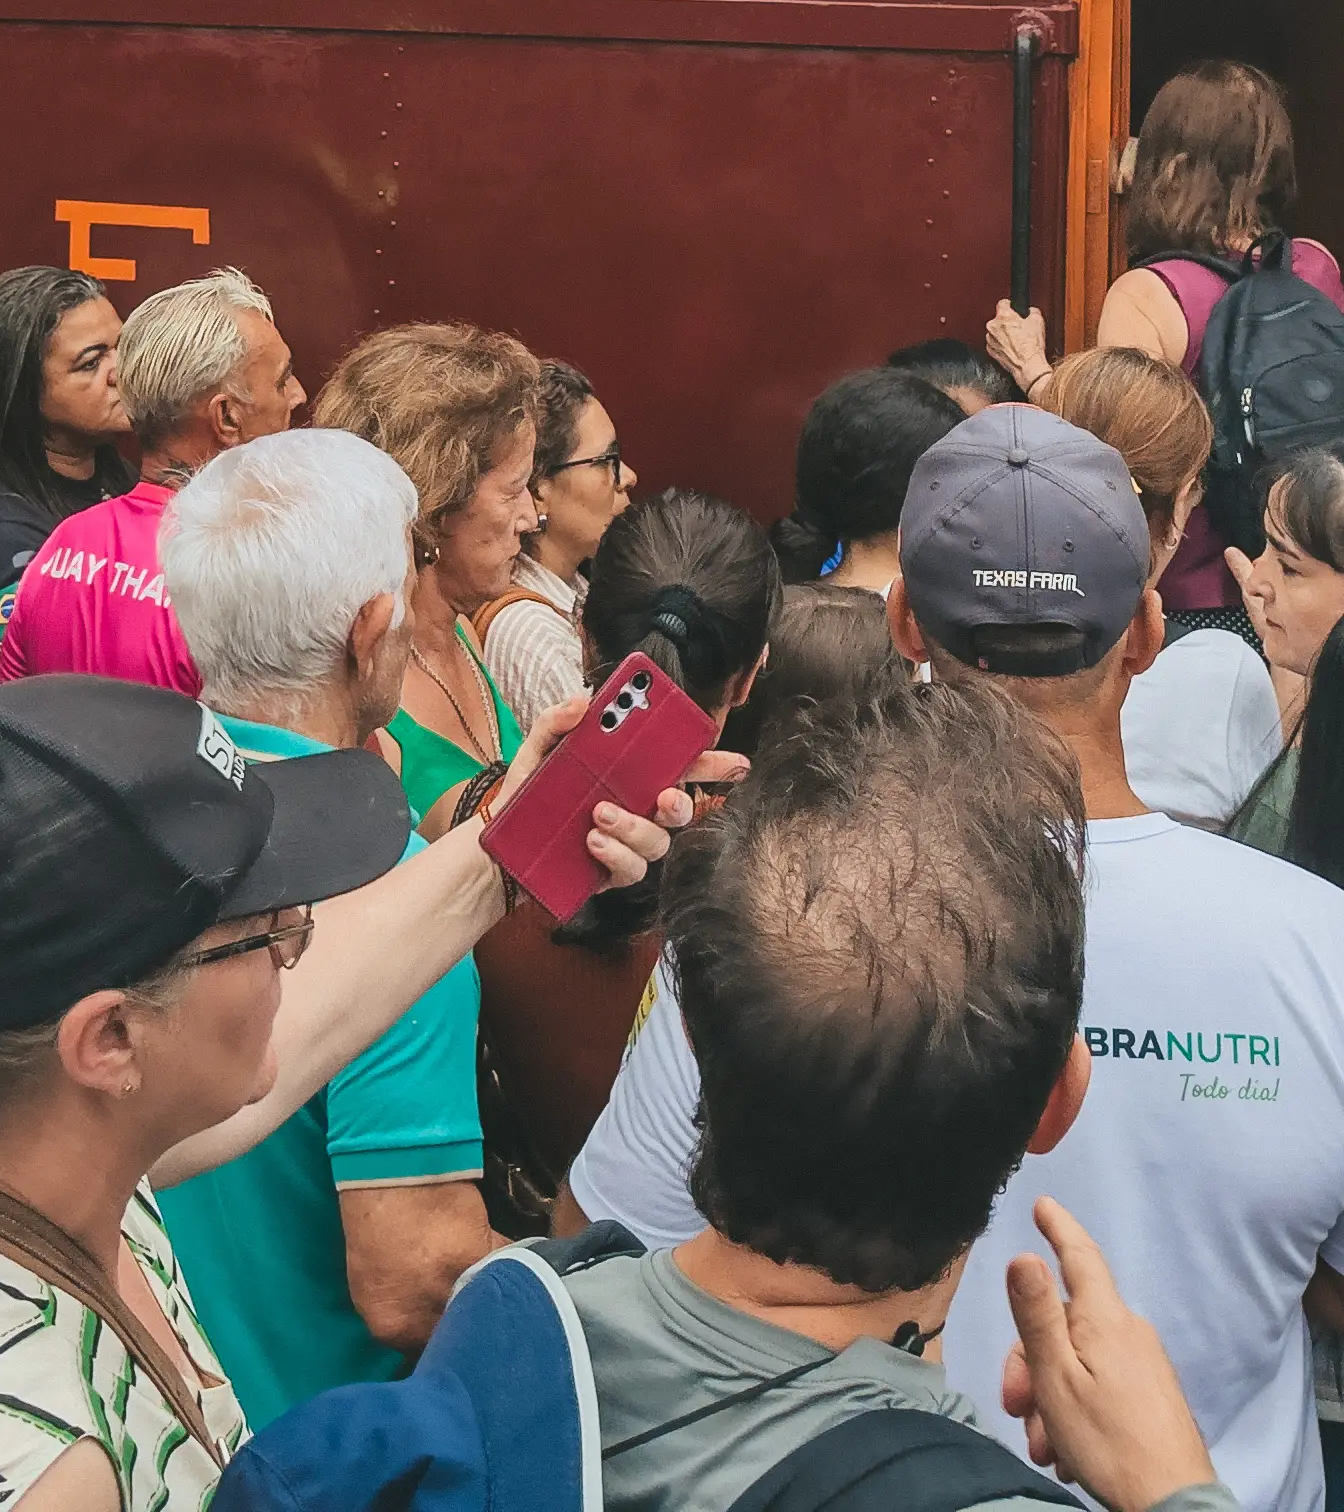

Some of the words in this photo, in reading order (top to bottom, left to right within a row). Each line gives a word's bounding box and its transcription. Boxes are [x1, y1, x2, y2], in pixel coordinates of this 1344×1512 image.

[109, 562, 171, 609] THA
[972, 569, 1027, 588] TEXAS
[1029, 571, 1086, 597] FARM
[1179, 1073, 1231, 1102] Todo
[1237, 1078, 1281, 1102] dia!
